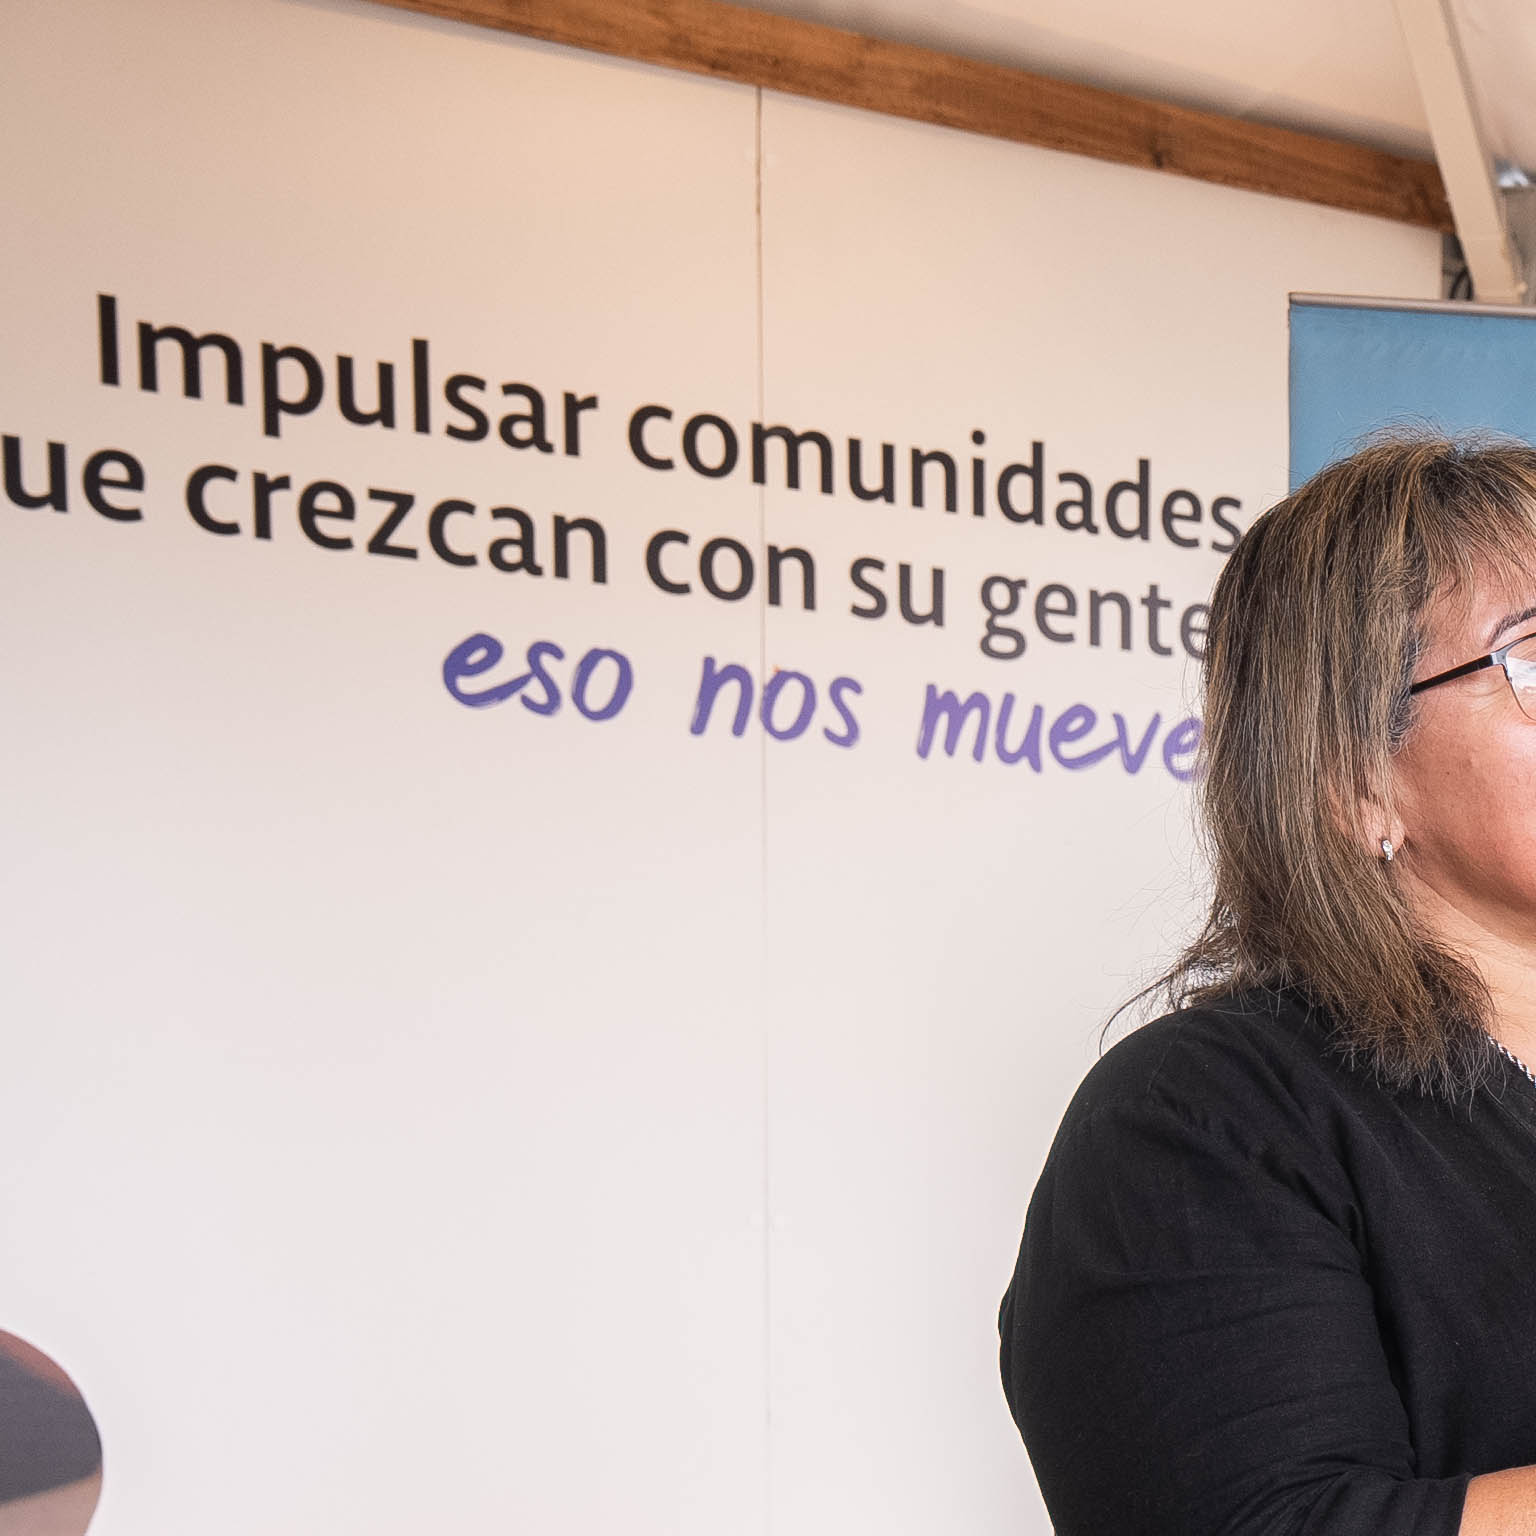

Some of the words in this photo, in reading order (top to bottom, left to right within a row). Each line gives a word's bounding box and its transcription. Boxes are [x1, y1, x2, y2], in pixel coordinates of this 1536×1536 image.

[96, 292, 600, 457] Impulsar
[627, 400, 1246, 556] comunidades
[0, 432, 146, 523] ue
[184, 457, 608, 585] crezcan
[645, 524, 818, 610] con
[849, 552, 946, 628] su
[979, 574, 1211, 661] gente
[441, 630, 635, 724] eso
[690, 655, 864, 749] nos
[916, 682, 1206, 783] mueve
